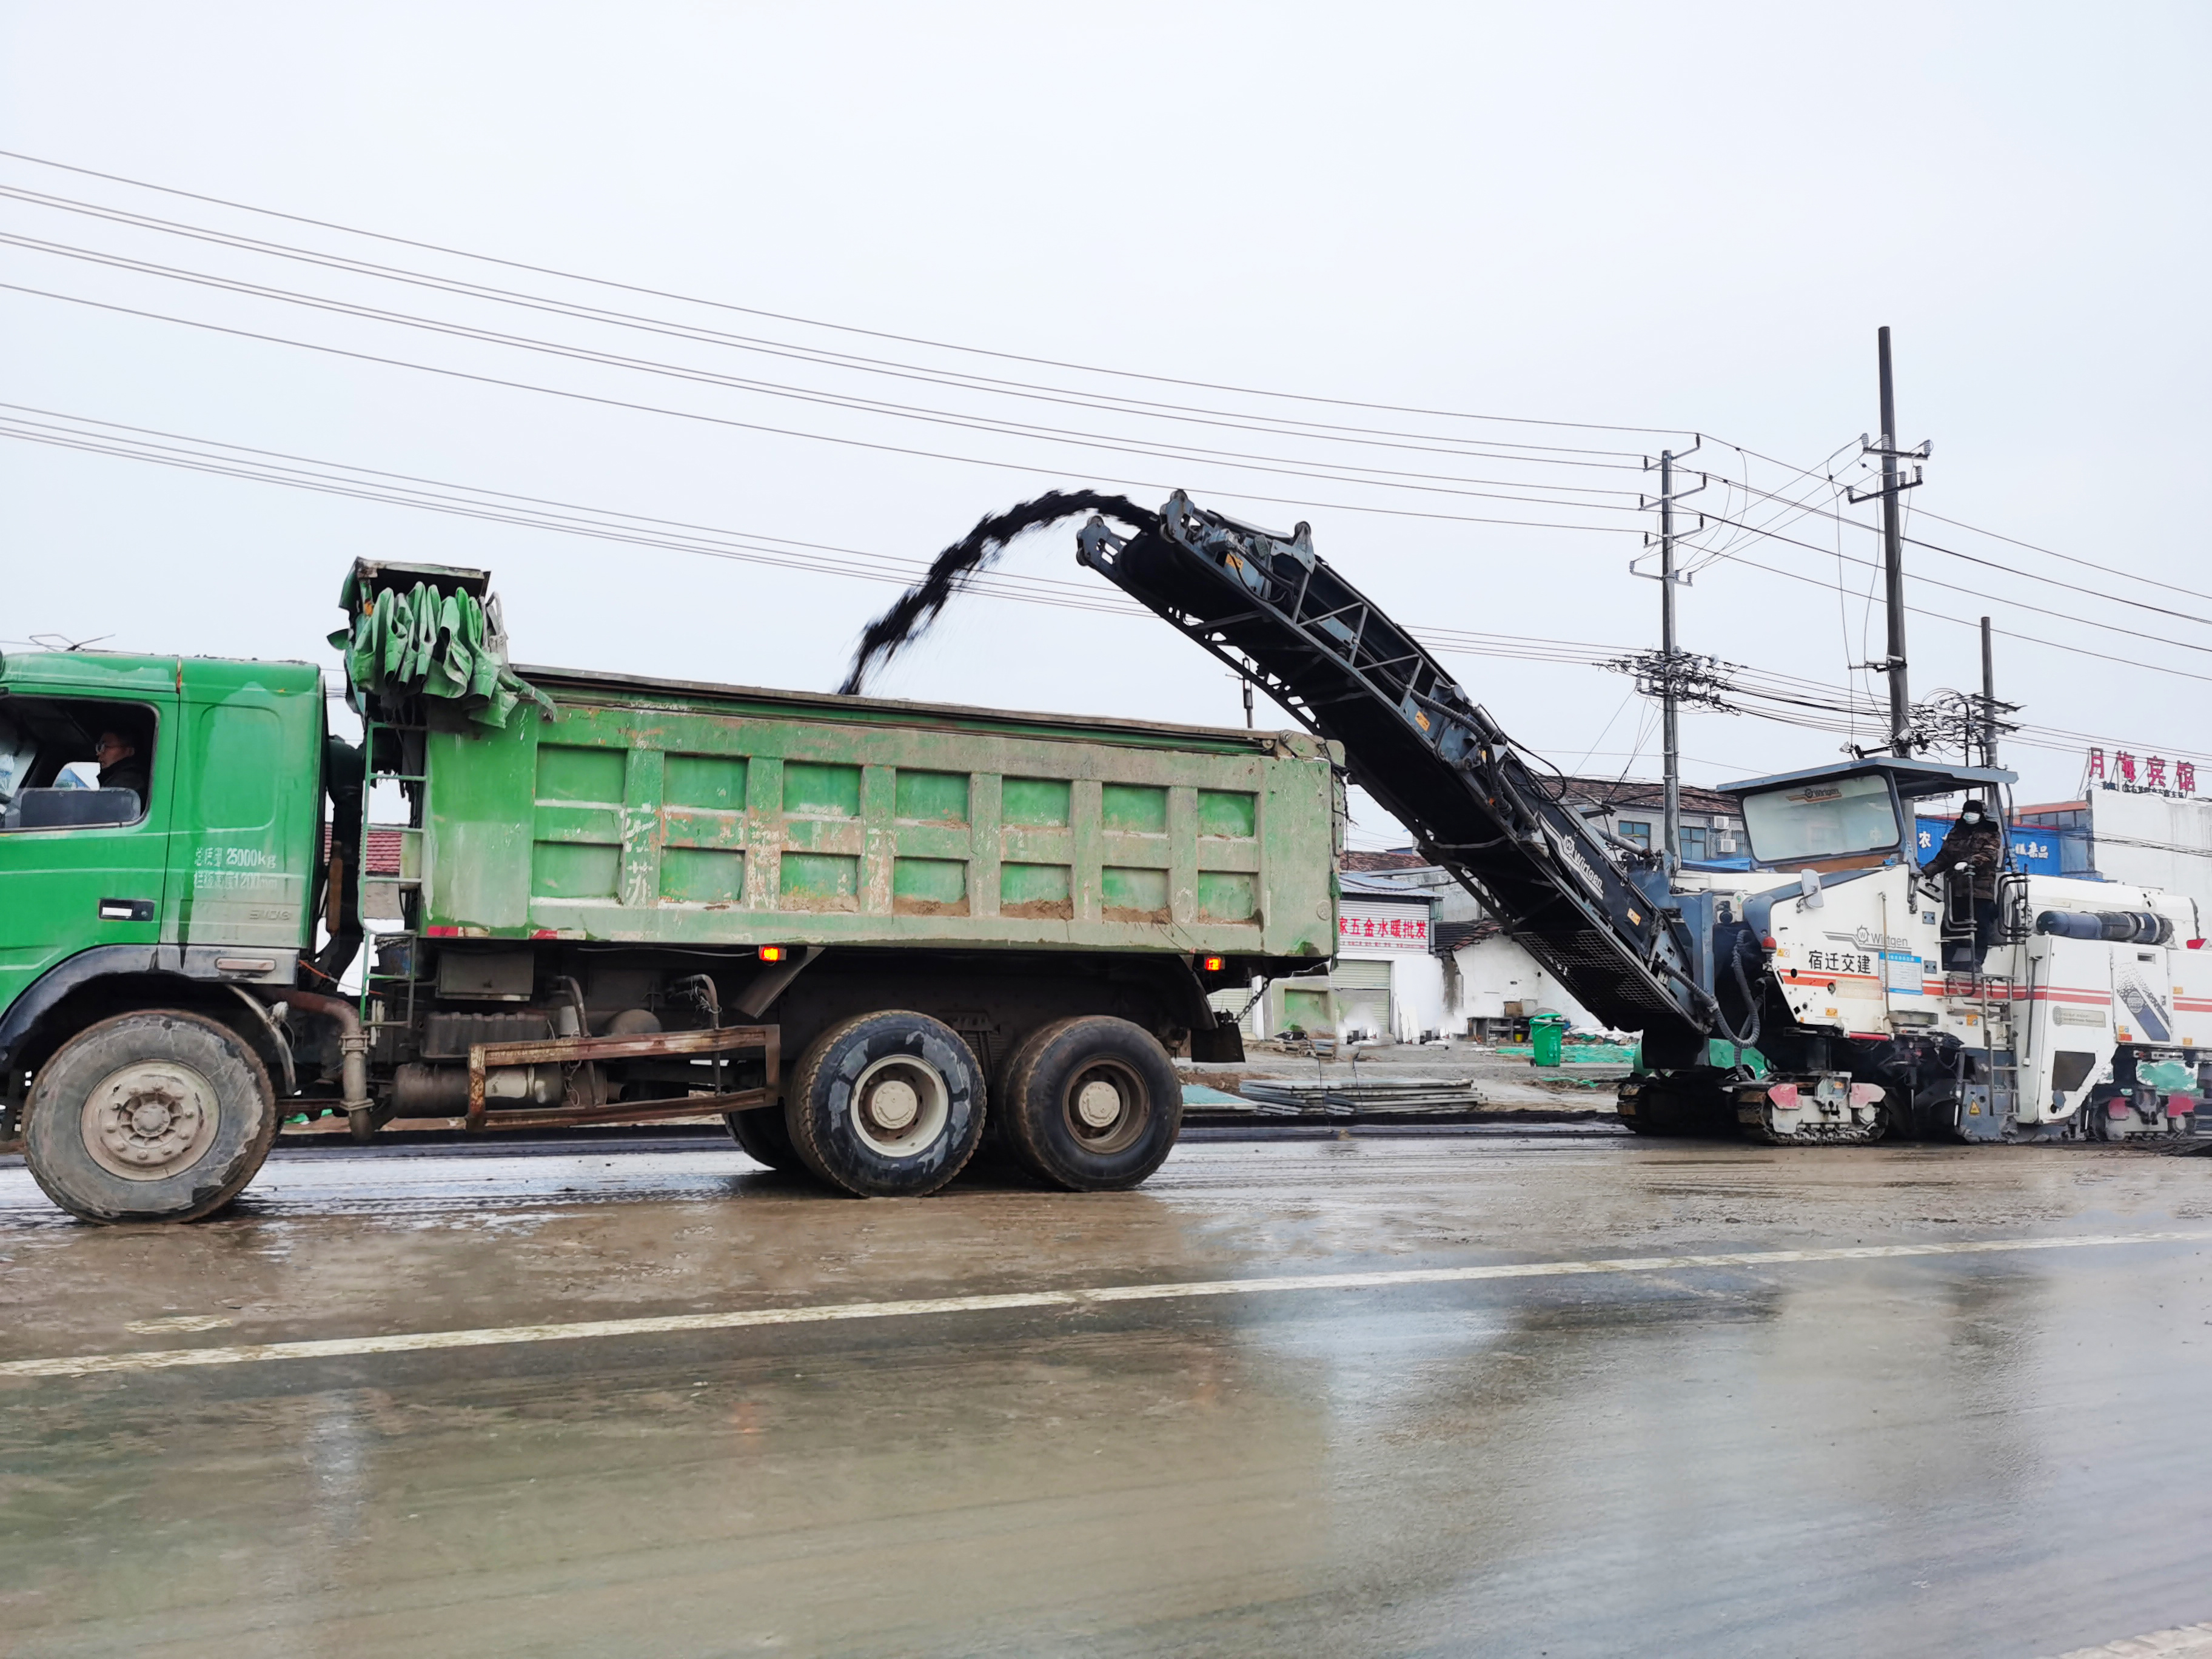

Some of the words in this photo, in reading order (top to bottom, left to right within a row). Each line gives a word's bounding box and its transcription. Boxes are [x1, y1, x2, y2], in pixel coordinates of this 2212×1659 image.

[1919, 831, 1932, 849] 农
[226, 847, 277, 868] 25000kg
[1574, 850, 1603, 888] Wirtgen
[1871, 933, 1908, 948] Witgen
[1808, 950, 1871, 974] 宿迁交建
